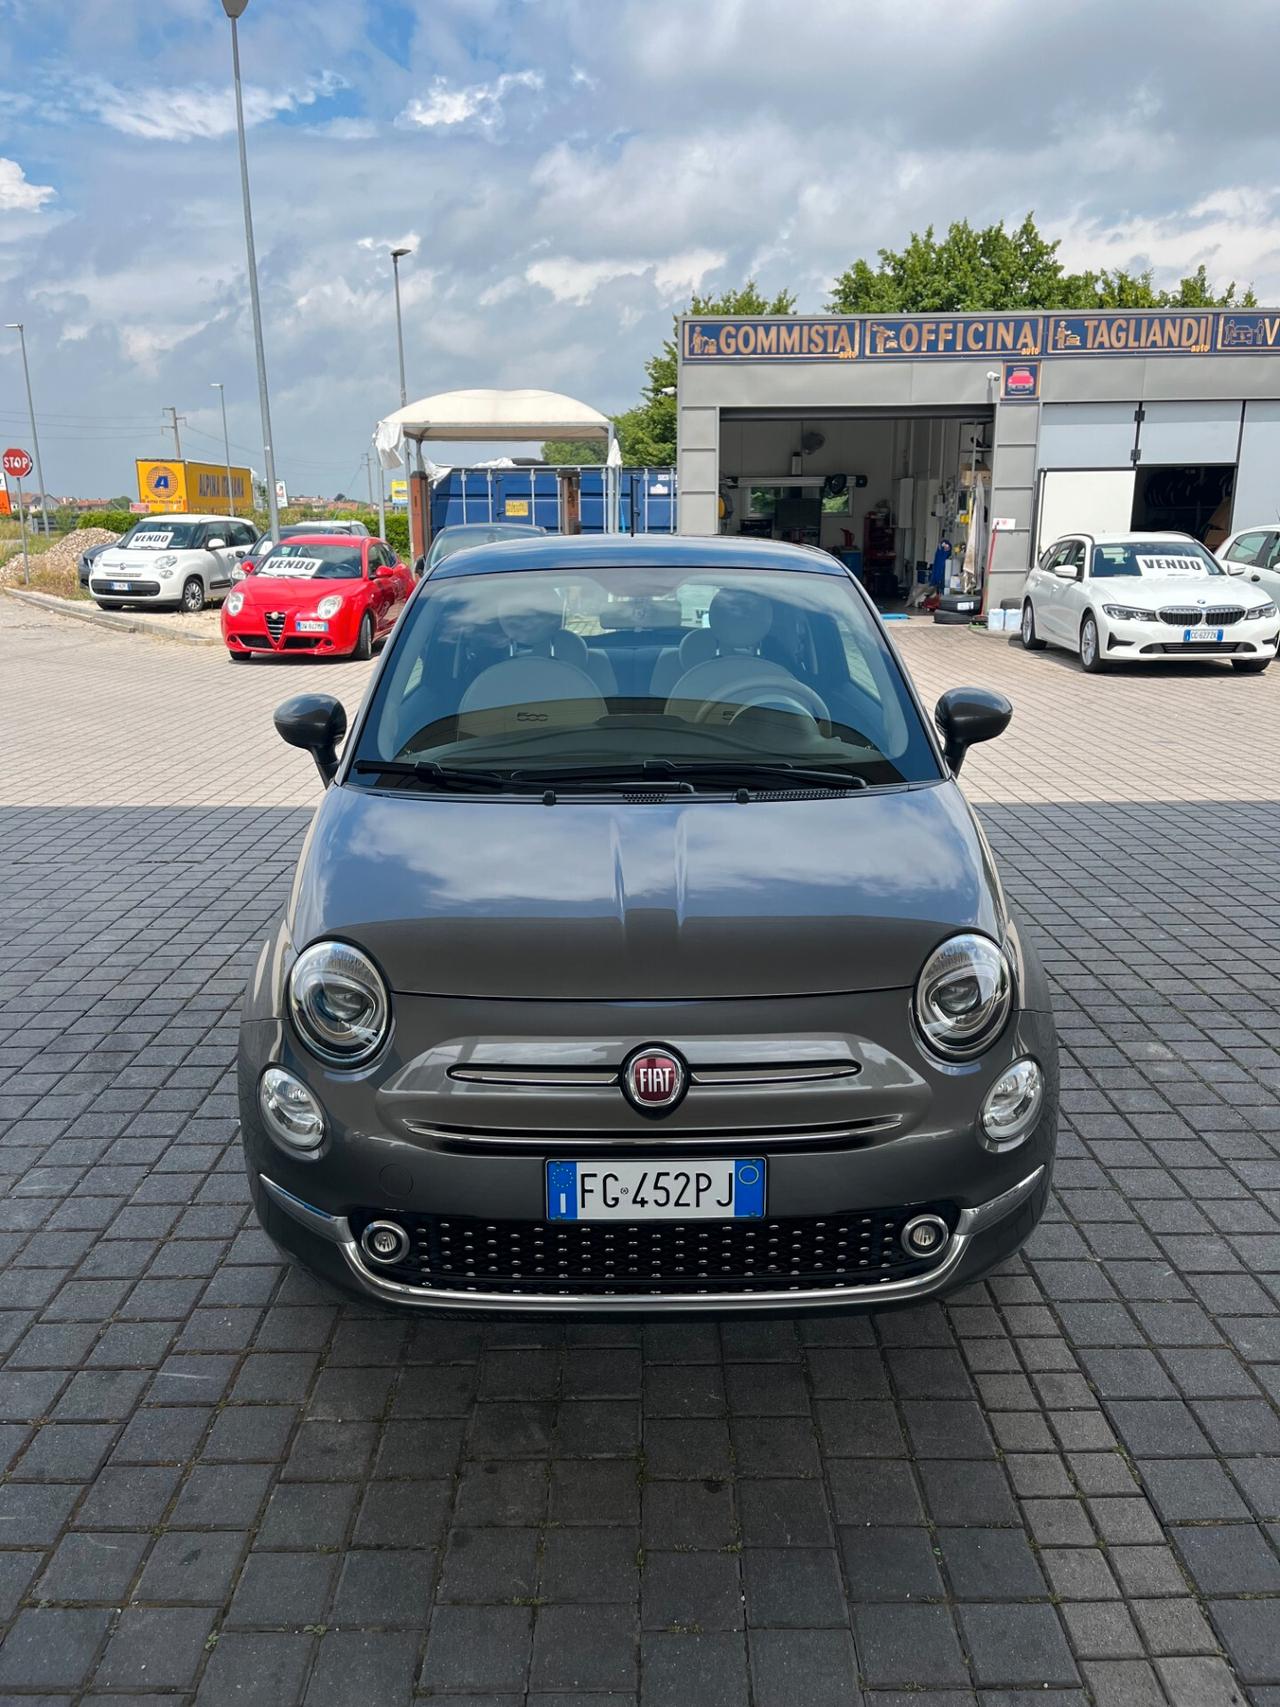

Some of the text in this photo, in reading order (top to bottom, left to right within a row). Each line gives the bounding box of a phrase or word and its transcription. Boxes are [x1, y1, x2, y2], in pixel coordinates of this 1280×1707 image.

[719, 324, 851, 354] GOMMISTA
[899, 321, 1034, 351] OFFICINA
[1084, 318, 1207, 348] TAGLIANDI
[1021, 346, 1039, 355] auto
[1190, 343, 1209, 353] auto
[3, 456, 28, 469] STOP
[134, 534, 169, 543] VENDO
[268, 560, 316, 571] VENDO
[1142, 558, 1202, 571] VENDO
[639, 1067, 672, 1093] FIAT
